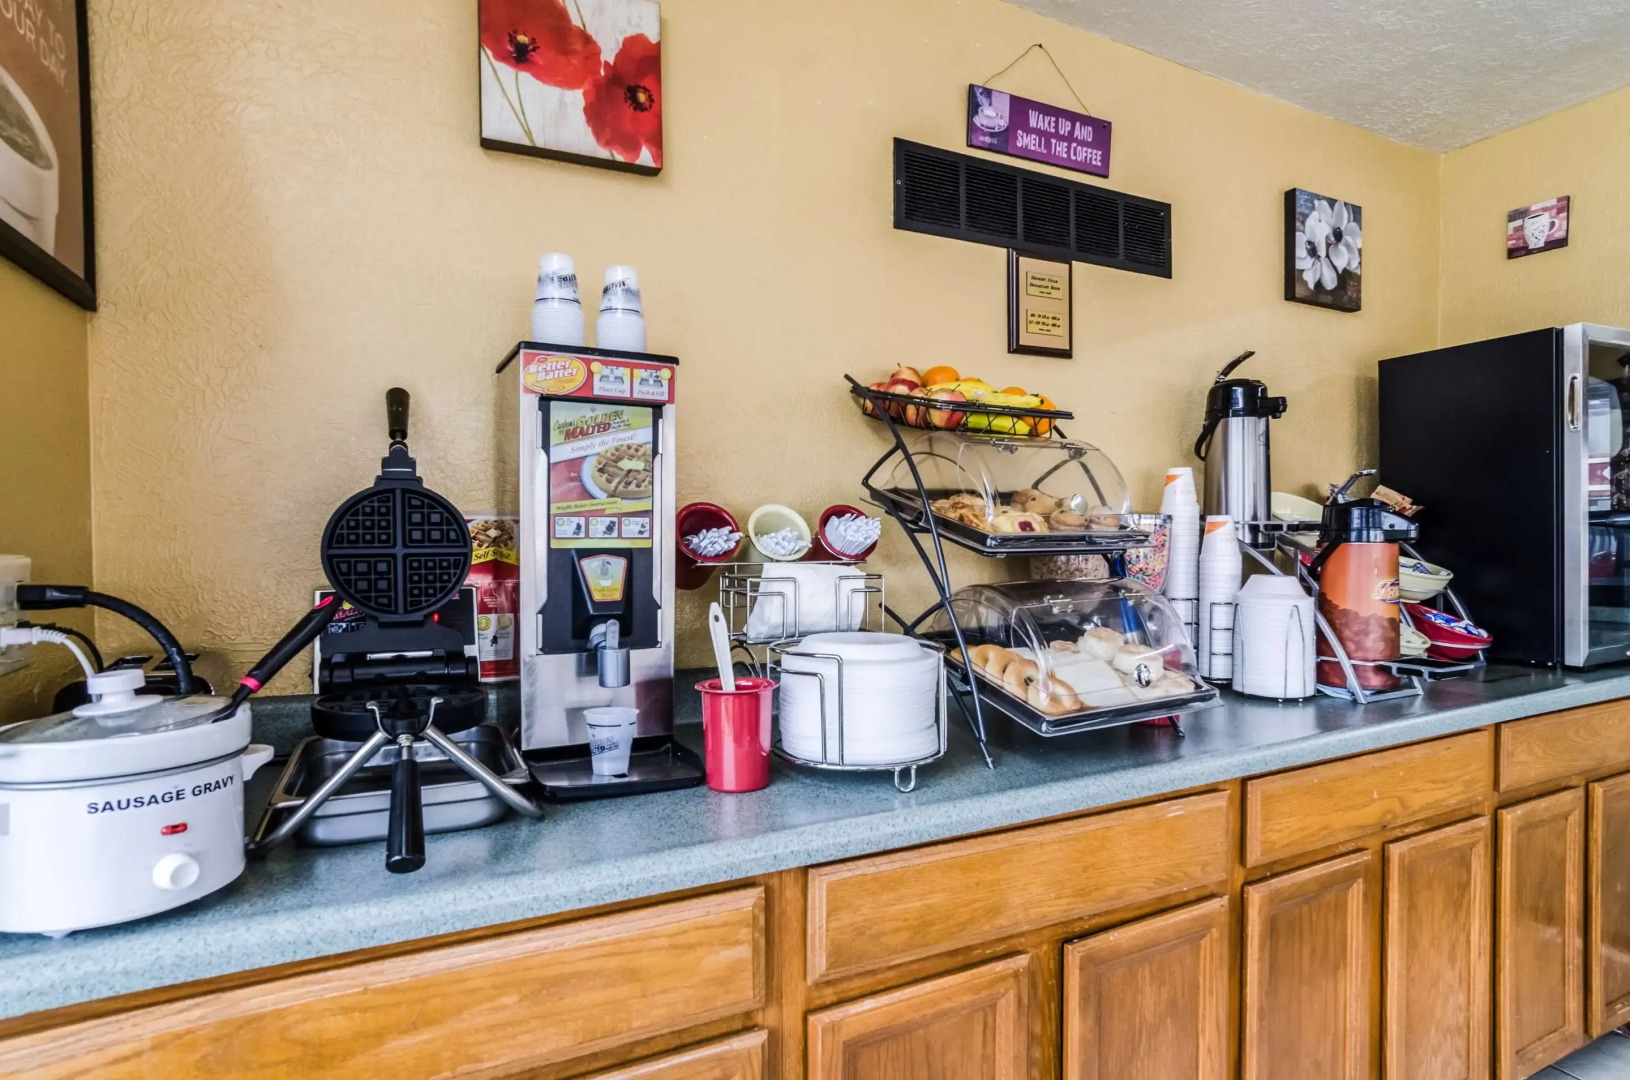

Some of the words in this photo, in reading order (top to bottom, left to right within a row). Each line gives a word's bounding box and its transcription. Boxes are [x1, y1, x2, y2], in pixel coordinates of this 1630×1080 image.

[47, 18, 66, 61] TO
[575, 409, 624, 429] GOLDEN
[563, 421, 612, 442] MALTED
[570, 440, 596, 453] Simply
[599, 436, 611, 447] the
[474, 549, 490, 561] Self
[87, 788, 186, 815] SAUSAGE
[192, 775, 235, 797] GRAVY
